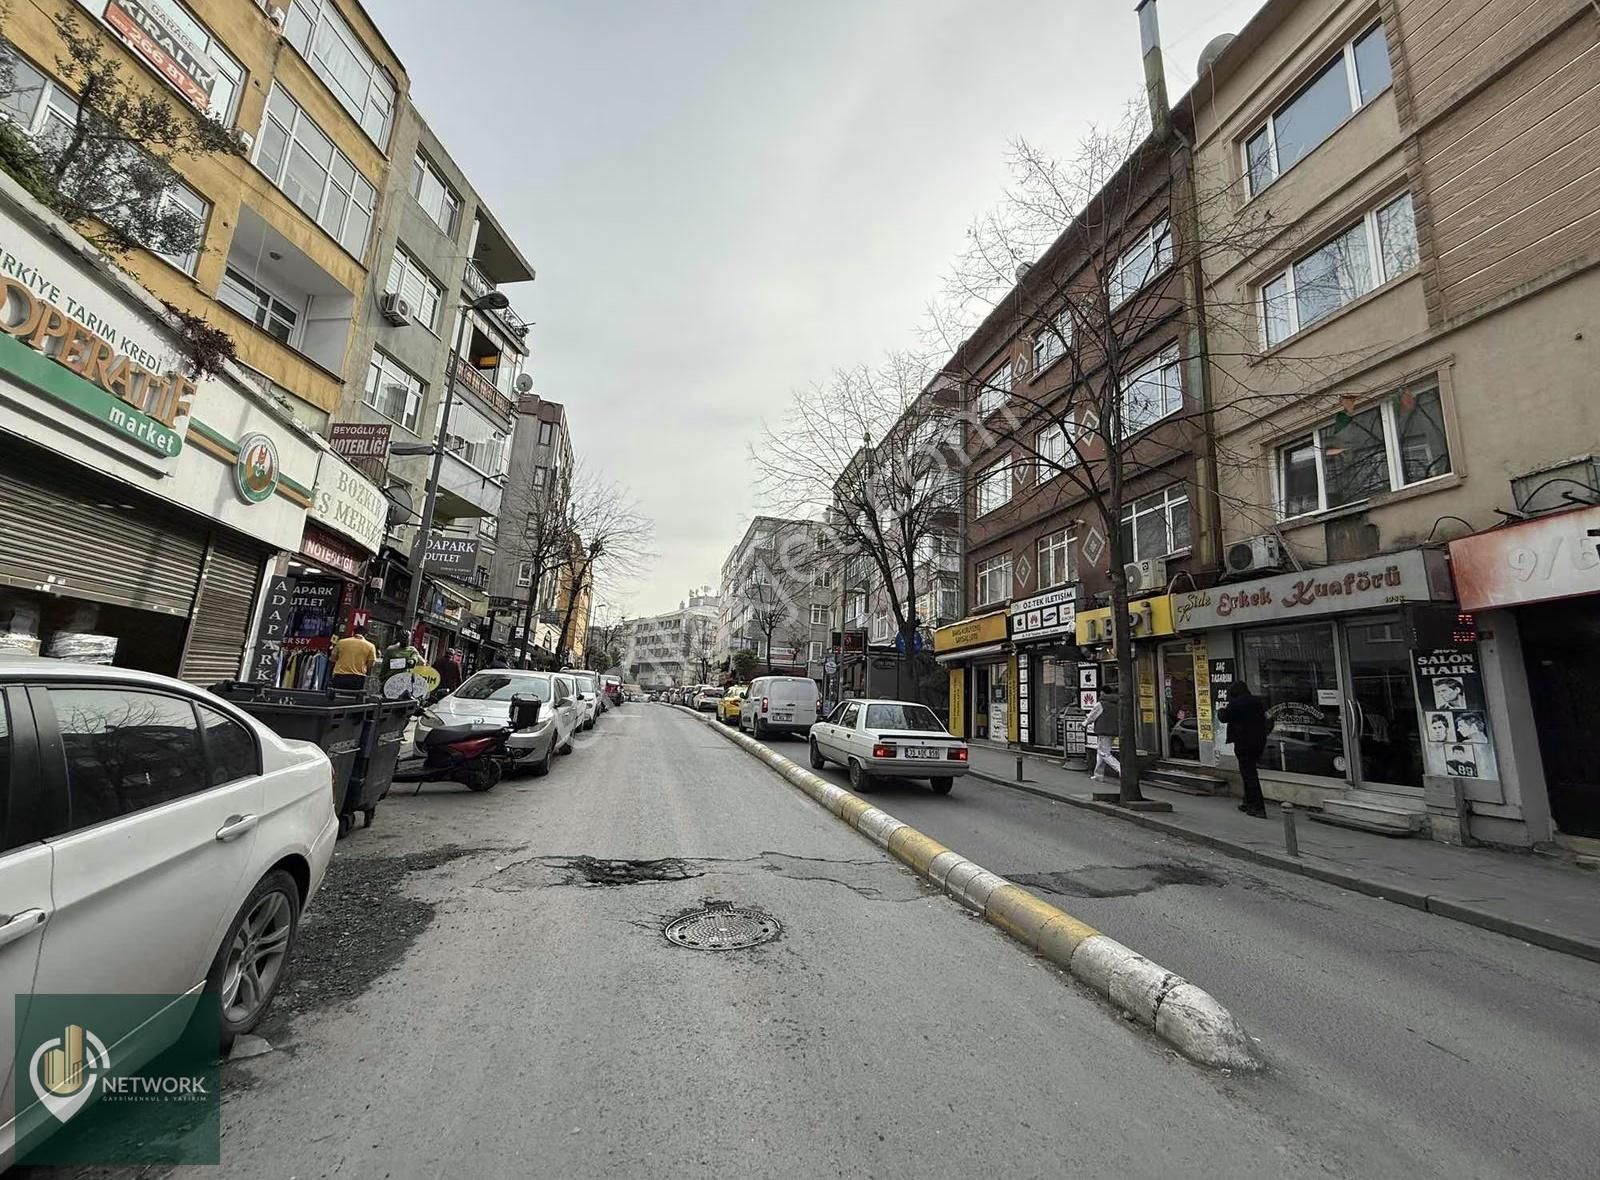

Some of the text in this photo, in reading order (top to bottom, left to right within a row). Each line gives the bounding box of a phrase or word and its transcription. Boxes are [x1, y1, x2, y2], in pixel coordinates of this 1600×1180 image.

[119, 0, 217, 92] KİRALIK
[0, 247, 163, 375] RKİYE TARIM KREDİ
[109, 404, 176, 454] market
[333, 426, 375, 435] BEYOĞLU
[330, 436, 387, 455] NOTERLİĞİ
[424, 552, 461, 563] OUTLET
[1216, 587, 1272, 617] Erkek
[1282, 566, 1402, 609] Kuaförü
[1417, 653, 1474, 666] SALON
[1420, 664, 1477, 676] HAIR
